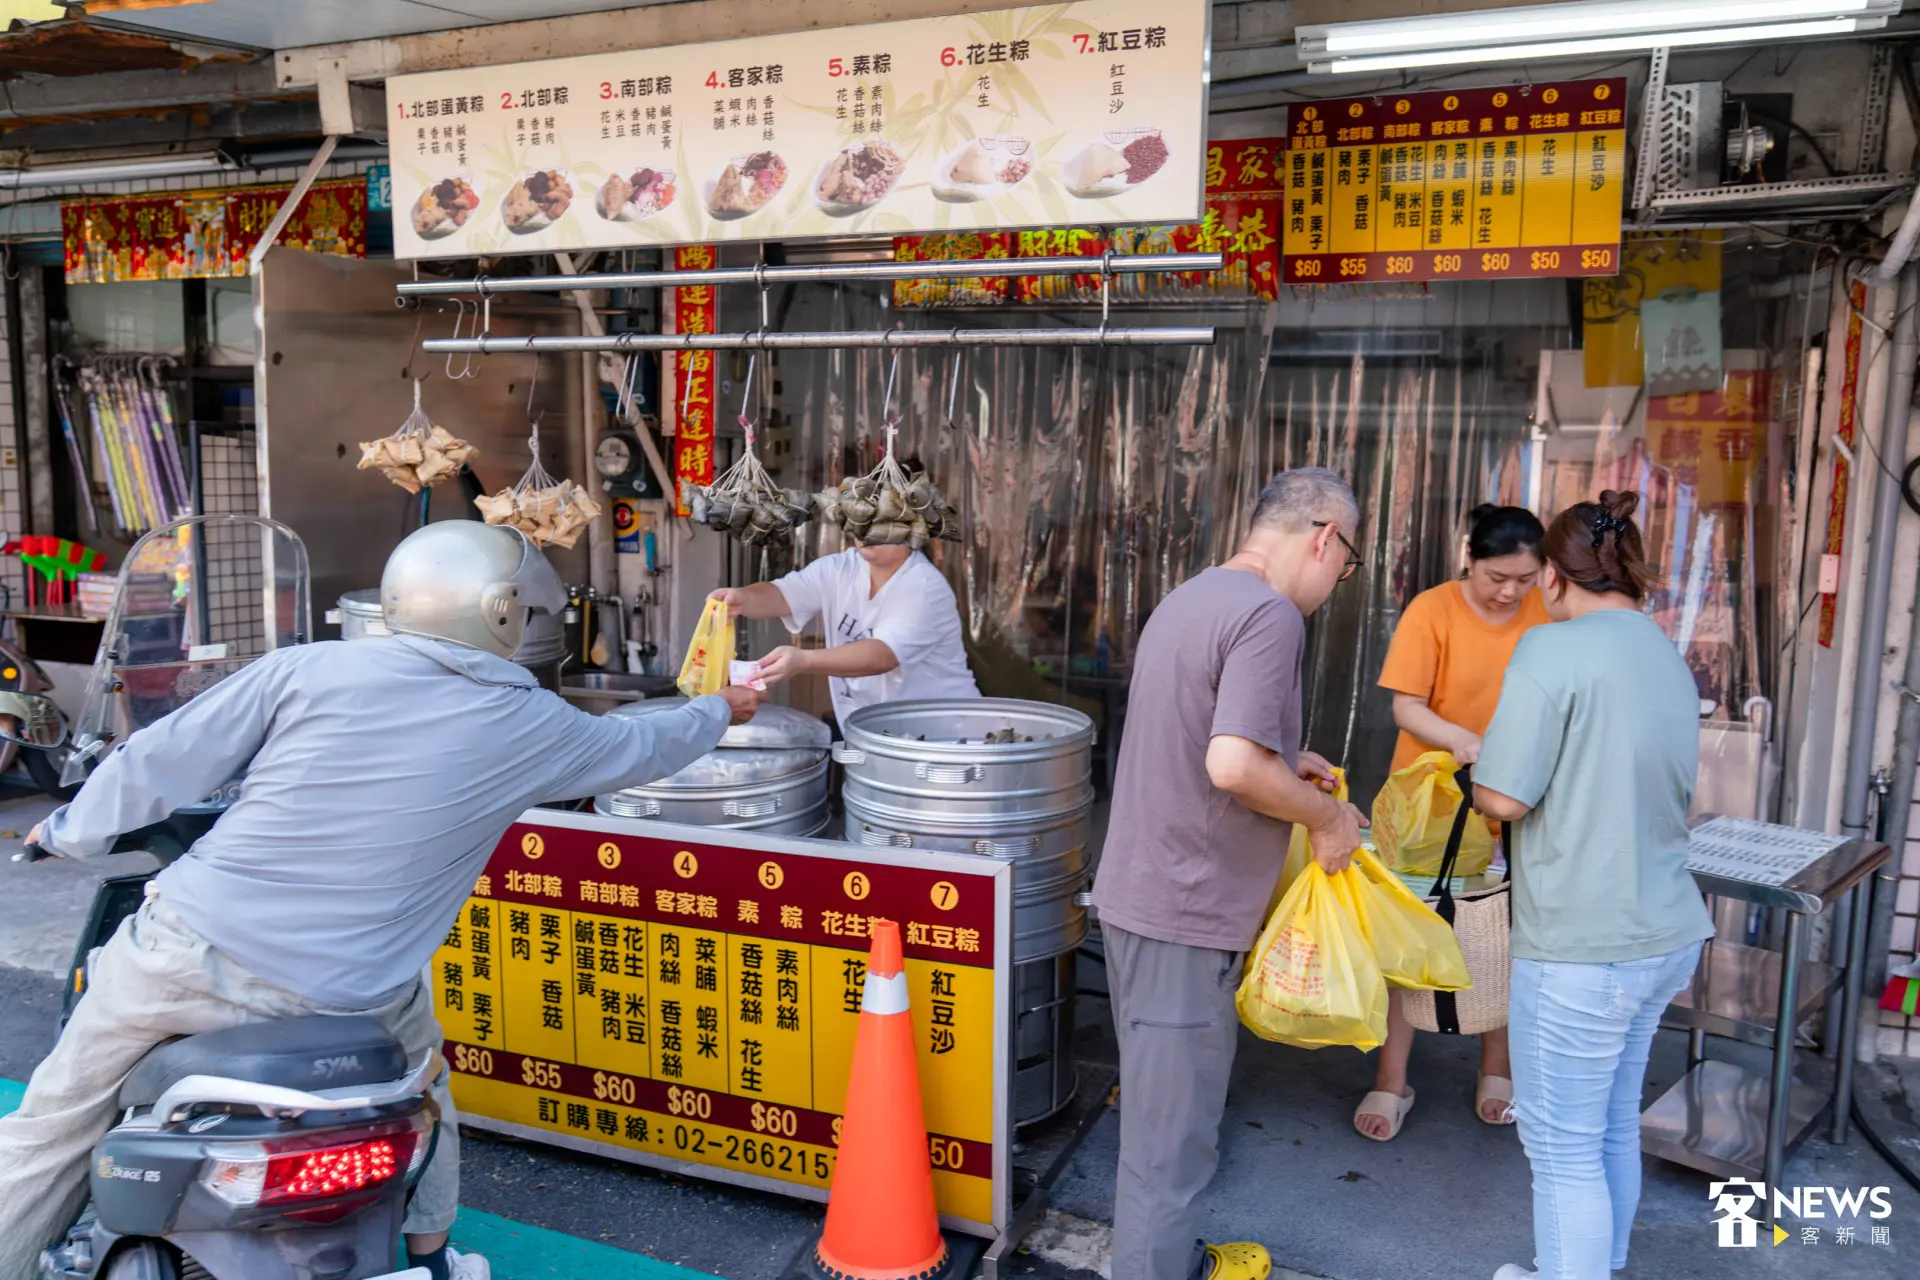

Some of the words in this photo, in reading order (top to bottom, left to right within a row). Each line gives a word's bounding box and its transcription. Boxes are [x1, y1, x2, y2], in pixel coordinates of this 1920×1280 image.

[940, 40, 1030, 67] 6.花生粽
[1072, 26, 1167, 54] 7.紅豆粽
[705, 64, 783, 89] 4.客家粽
[828, 53, 892, 77] 5.素粽
[501, 86, 569, 110] 2.北部粽
[600, 75, 672, 99] 3.南部粽
[977, 75, 990, 108] 花生
[397, 95, 484, 119] 1.北部蛋黃粽
[836, 88, 848, 119] 花生
[853, 86, 865, 134] 香菇絲
[870, 85, 883, 133] 素肉絲
[1580, 110, 1621, 125] 紅豆粽
[600, 109, 611, 139] 花生
[615, 108, 626, 138] 米豆
[631, 107, 641, 137] 香菇
[1337, 126, 1374, 141] 北部粽
[1384, 123, 1421, 139] 南部粽
[1431, 119, 1470, 135] 客家粽
[1529, 113, 1569, 129] 花生粽
[1295, 259, 1321, 277] $60
[1340, 257, 1366, 276] $55
[1386, 256, 1413, 275] $60
[1433, 254, 1461, 273] $60
[1482, 252, 1510, 271] $60
[1531, 251, 1560, 270] $50
[1581, 250, 1611, 269] $50
[505, 870, 563, 897] 北部粽
[579, 880, 639, 907] 南部粽
[655, 889, 718, 918] 客家粽
[443, 912, 461, 949] 菇
[470, 904, 491, 980] 鹹蛋黃
[509, 909, 530, 961] 豬肉
[540, 913, 561, 965] 栗子
[907, 920, 980, 952] 紅豆粽
[574, 919, 596, 998] 鹹蛋黃
[598, 922, 619, 974] 香菇
[623, 926, 644, 978] 花生
[659, 932, 681, 985] 肉絲
[695, 937, 716, 992] 菜脯
[443, 961, 463, 1011] 豬肉
[740, 943, 763, 1025] 香菇絲
[776, 948, 800, 1031] 素肉絲
[843, 958, 866, 1014] 花生
[472, 992, 493, 1042] 栗子
[542, 979, 563, 1030] 香菇
[600, 988, 621, 1040] 豬肉
[624, 993, 646, 1045] 米豆
[930, 969, 956, 1054] 紅豆沙
[660, 999, 683, 1078] 香菇絲
[696, 1006, 719, 1059] 蝦米
[313, 1055, 361, 1078] SYM
[455, 1044, 493, 1076] $60
[521, 1057, 562, 1089] $55
[740, 1039, 762, 1092] 花生
[593, 1070, 636, 1104] $60
[667, 1085, 711, 1119] $60
[751, 1102, 798, 1137] $60
[930, 1138, 964, 1169] 50
